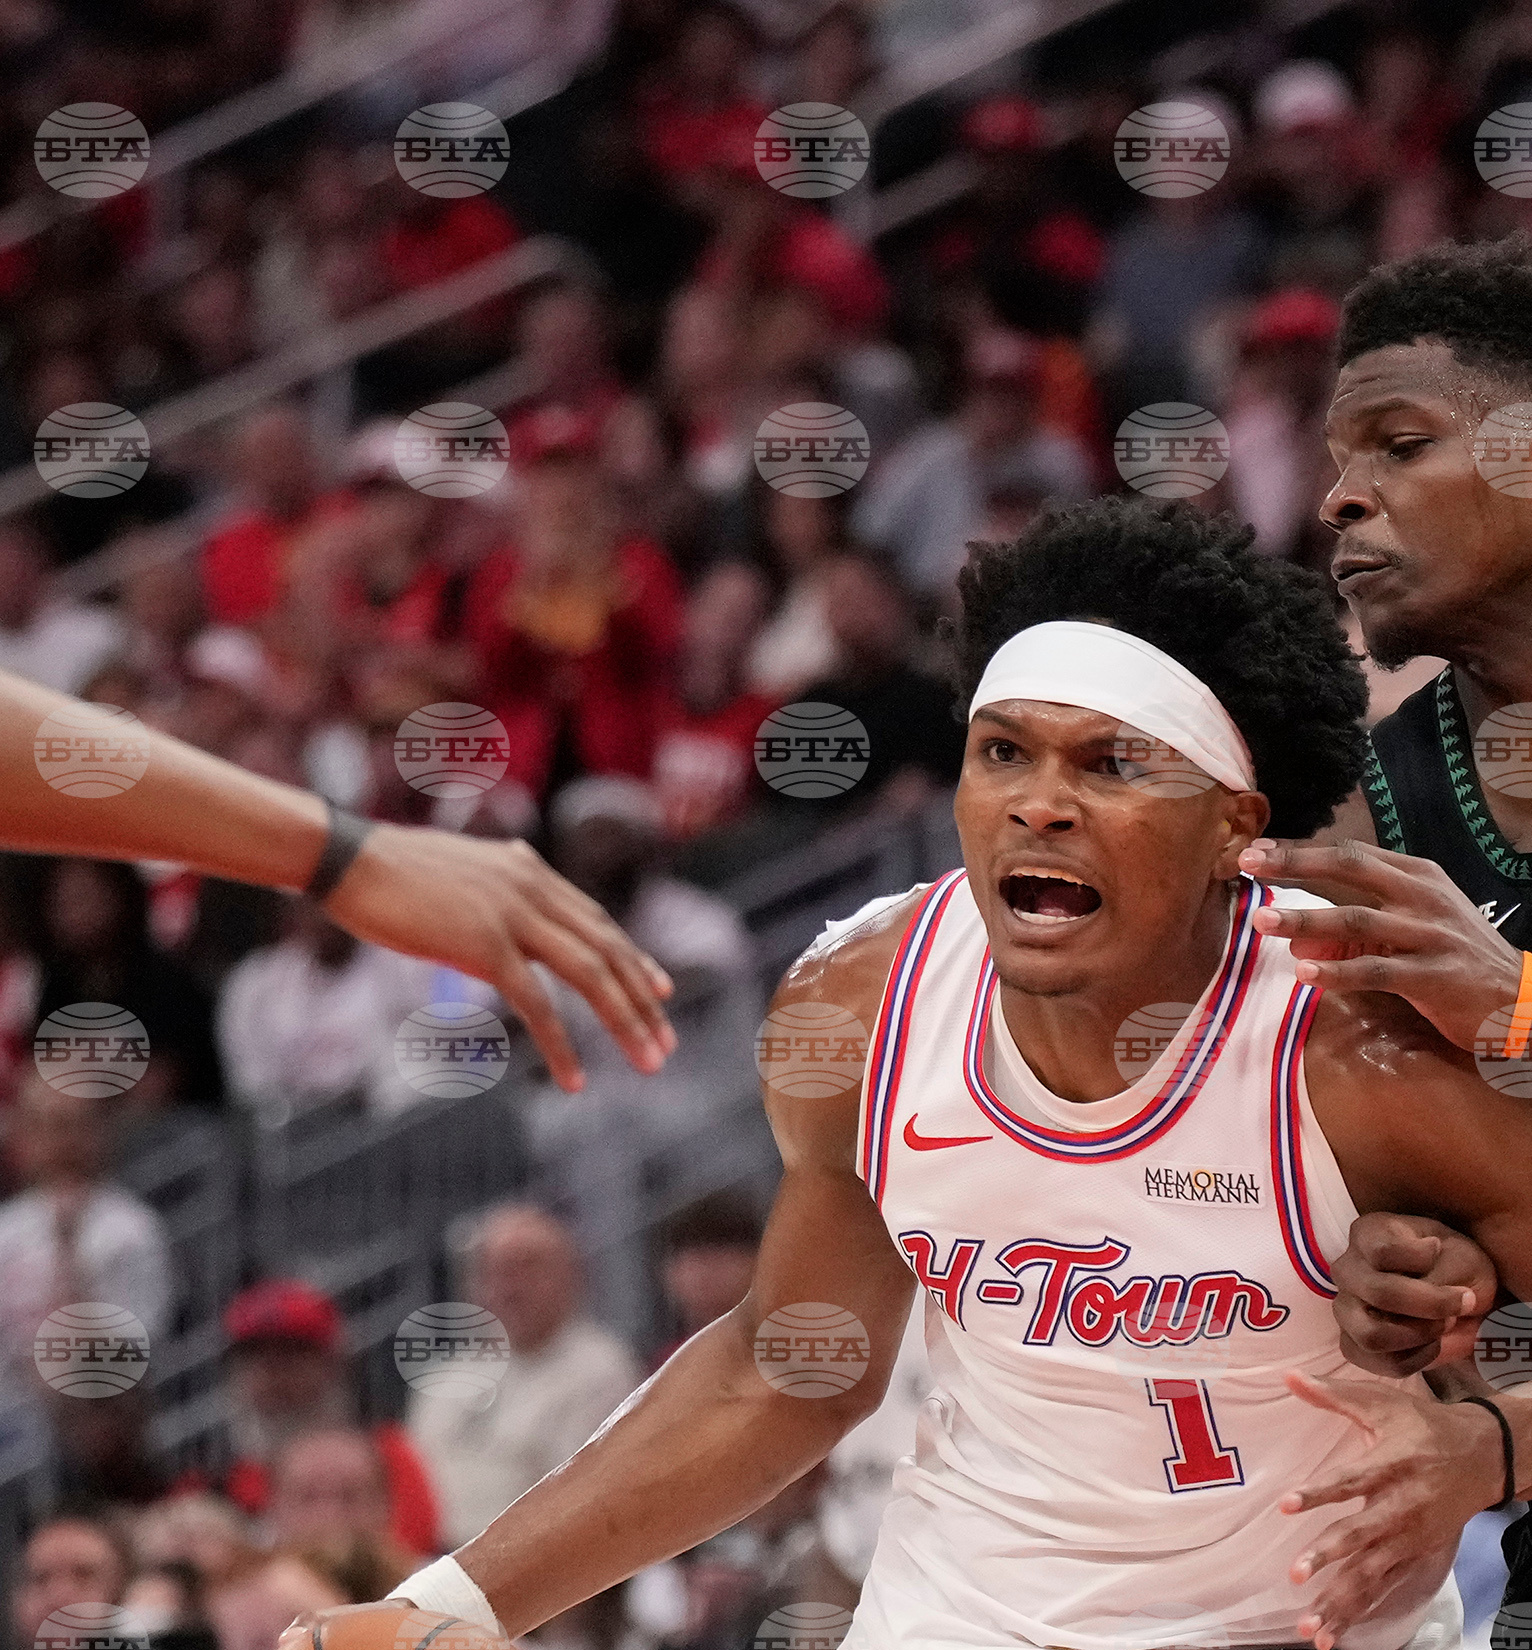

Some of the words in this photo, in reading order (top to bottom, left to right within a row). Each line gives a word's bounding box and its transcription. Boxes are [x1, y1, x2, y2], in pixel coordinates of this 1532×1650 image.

[1144, 1166, 1261, 1191] MEMORIAL
[1144, 1181, 1260, 1204] HERMANN
[897, 1229, 1291, 1349] H-Town
[1145, 1377, 1245, 1494] 1
